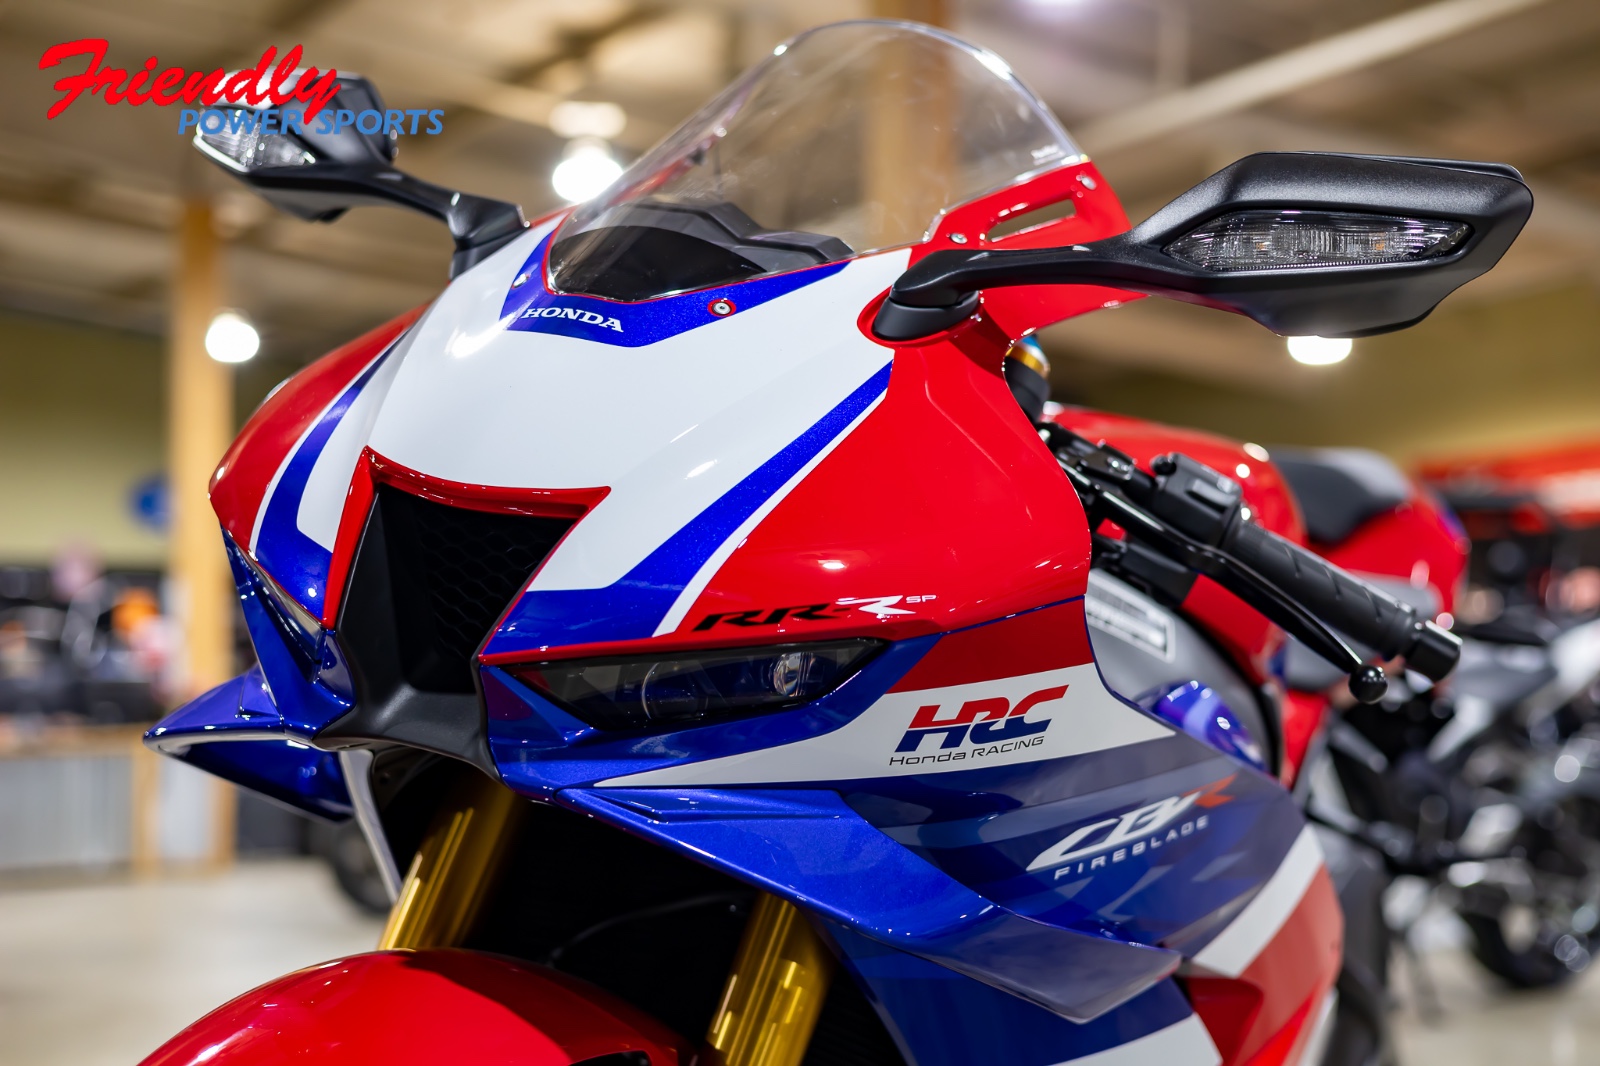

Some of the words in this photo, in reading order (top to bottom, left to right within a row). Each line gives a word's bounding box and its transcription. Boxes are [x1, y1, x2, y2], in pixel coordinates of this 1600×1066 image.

[520, 307, 624, 333] HONDA
[894, 684, 1070, 753] HRC
[889, 751, 967, 766] Honda
[970, 736, 1045, 759] RACING
[1054, 814, 1209, 880] FIREBLADE
